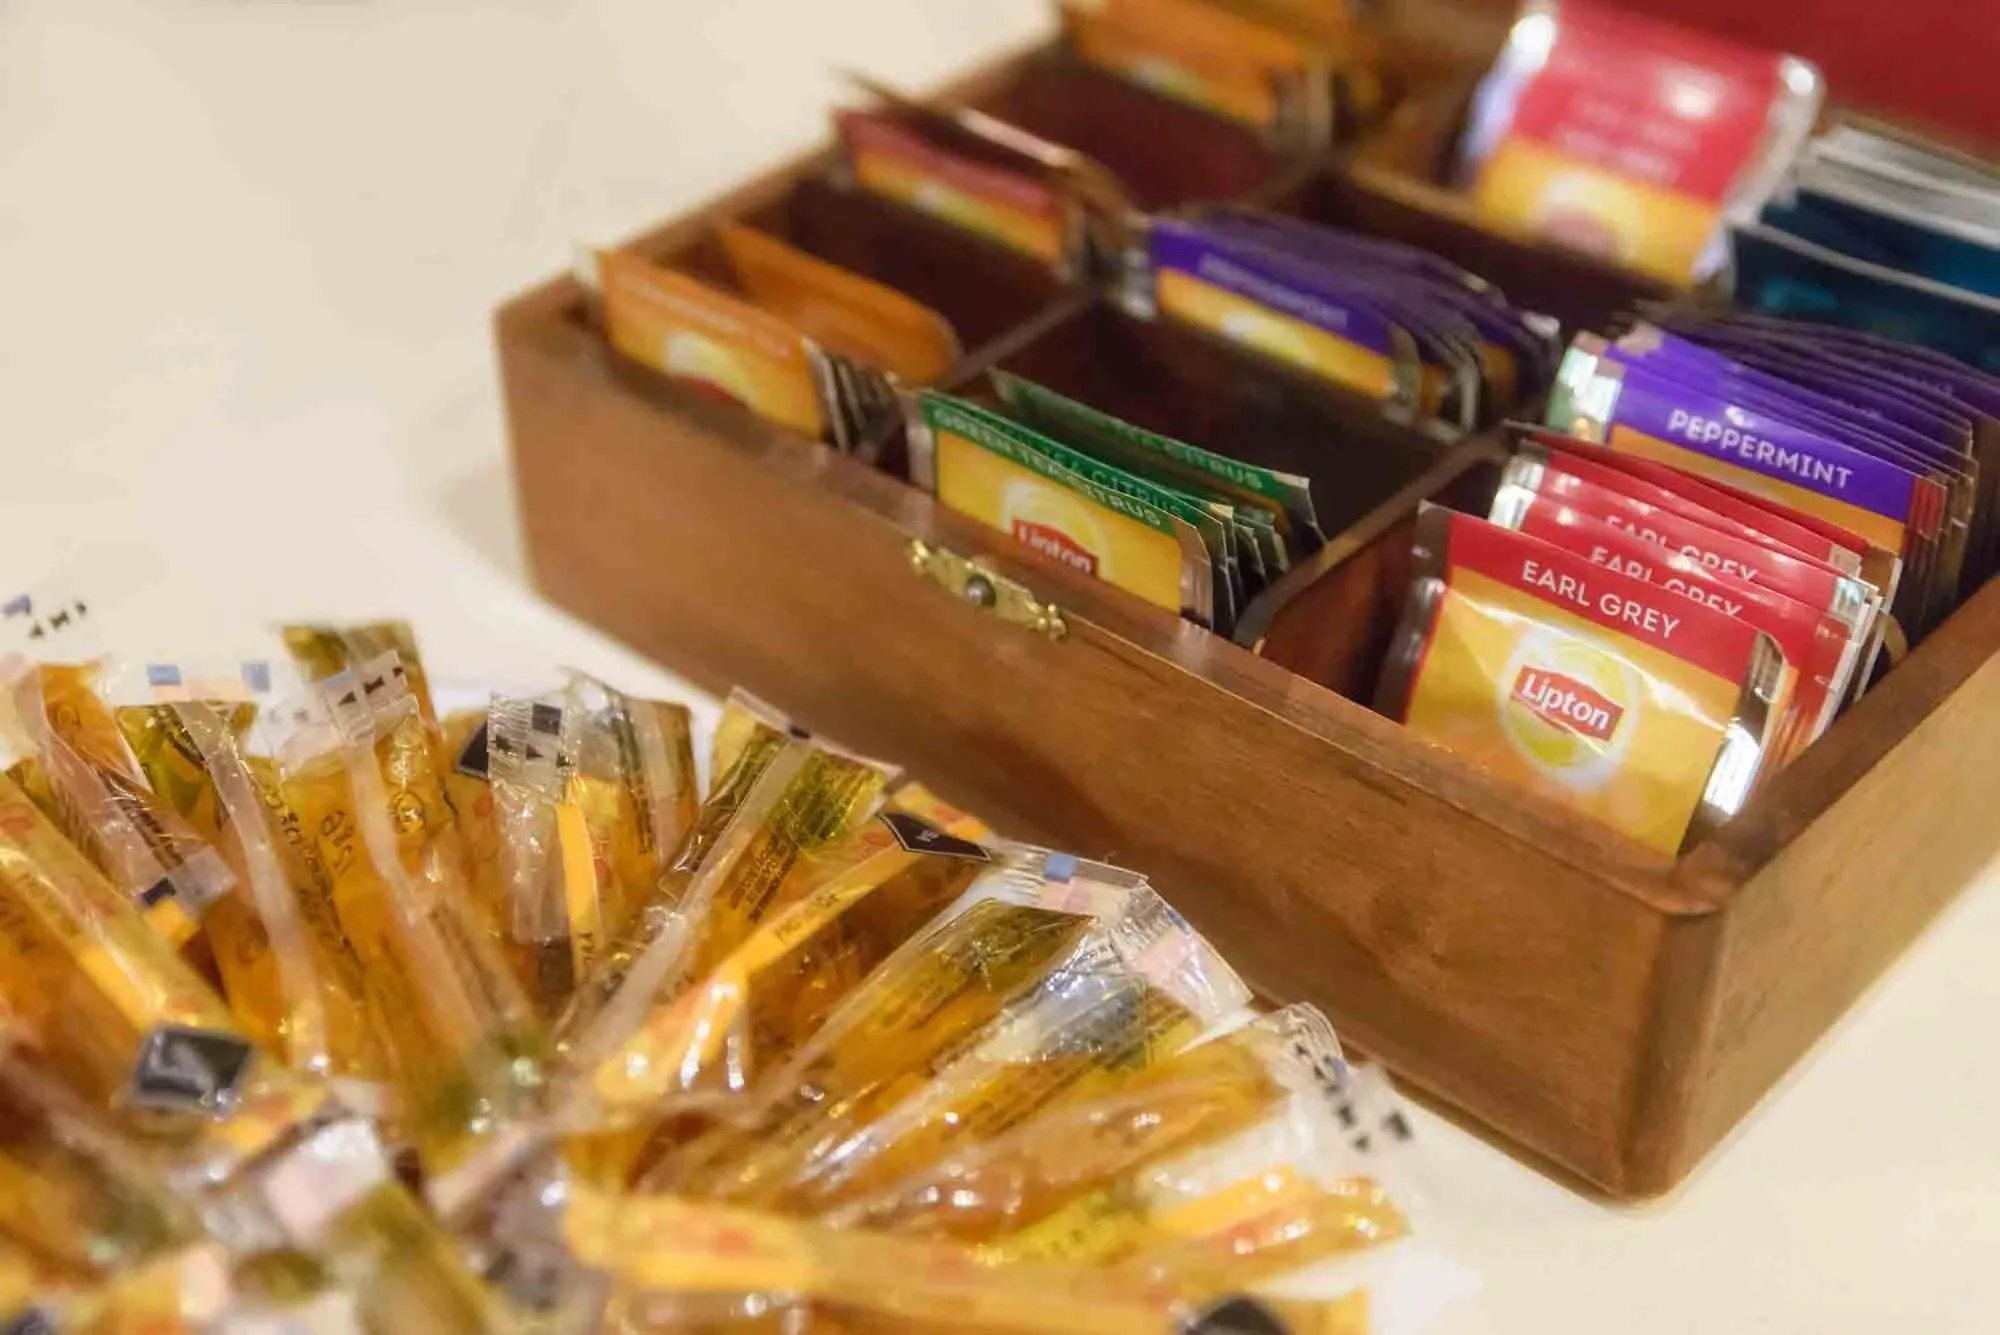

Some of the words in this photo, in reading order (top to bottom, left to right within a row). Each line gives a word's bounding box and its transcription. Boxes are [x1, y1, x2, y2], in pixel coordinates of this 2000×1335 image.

[1667, 409, 1853, 489] PEPPERMINT
[1521, 560, 1590, 607] EARL
[1600, 593, 1680, 639] GREY
[1521, 673, 1610, 731] Lipton
